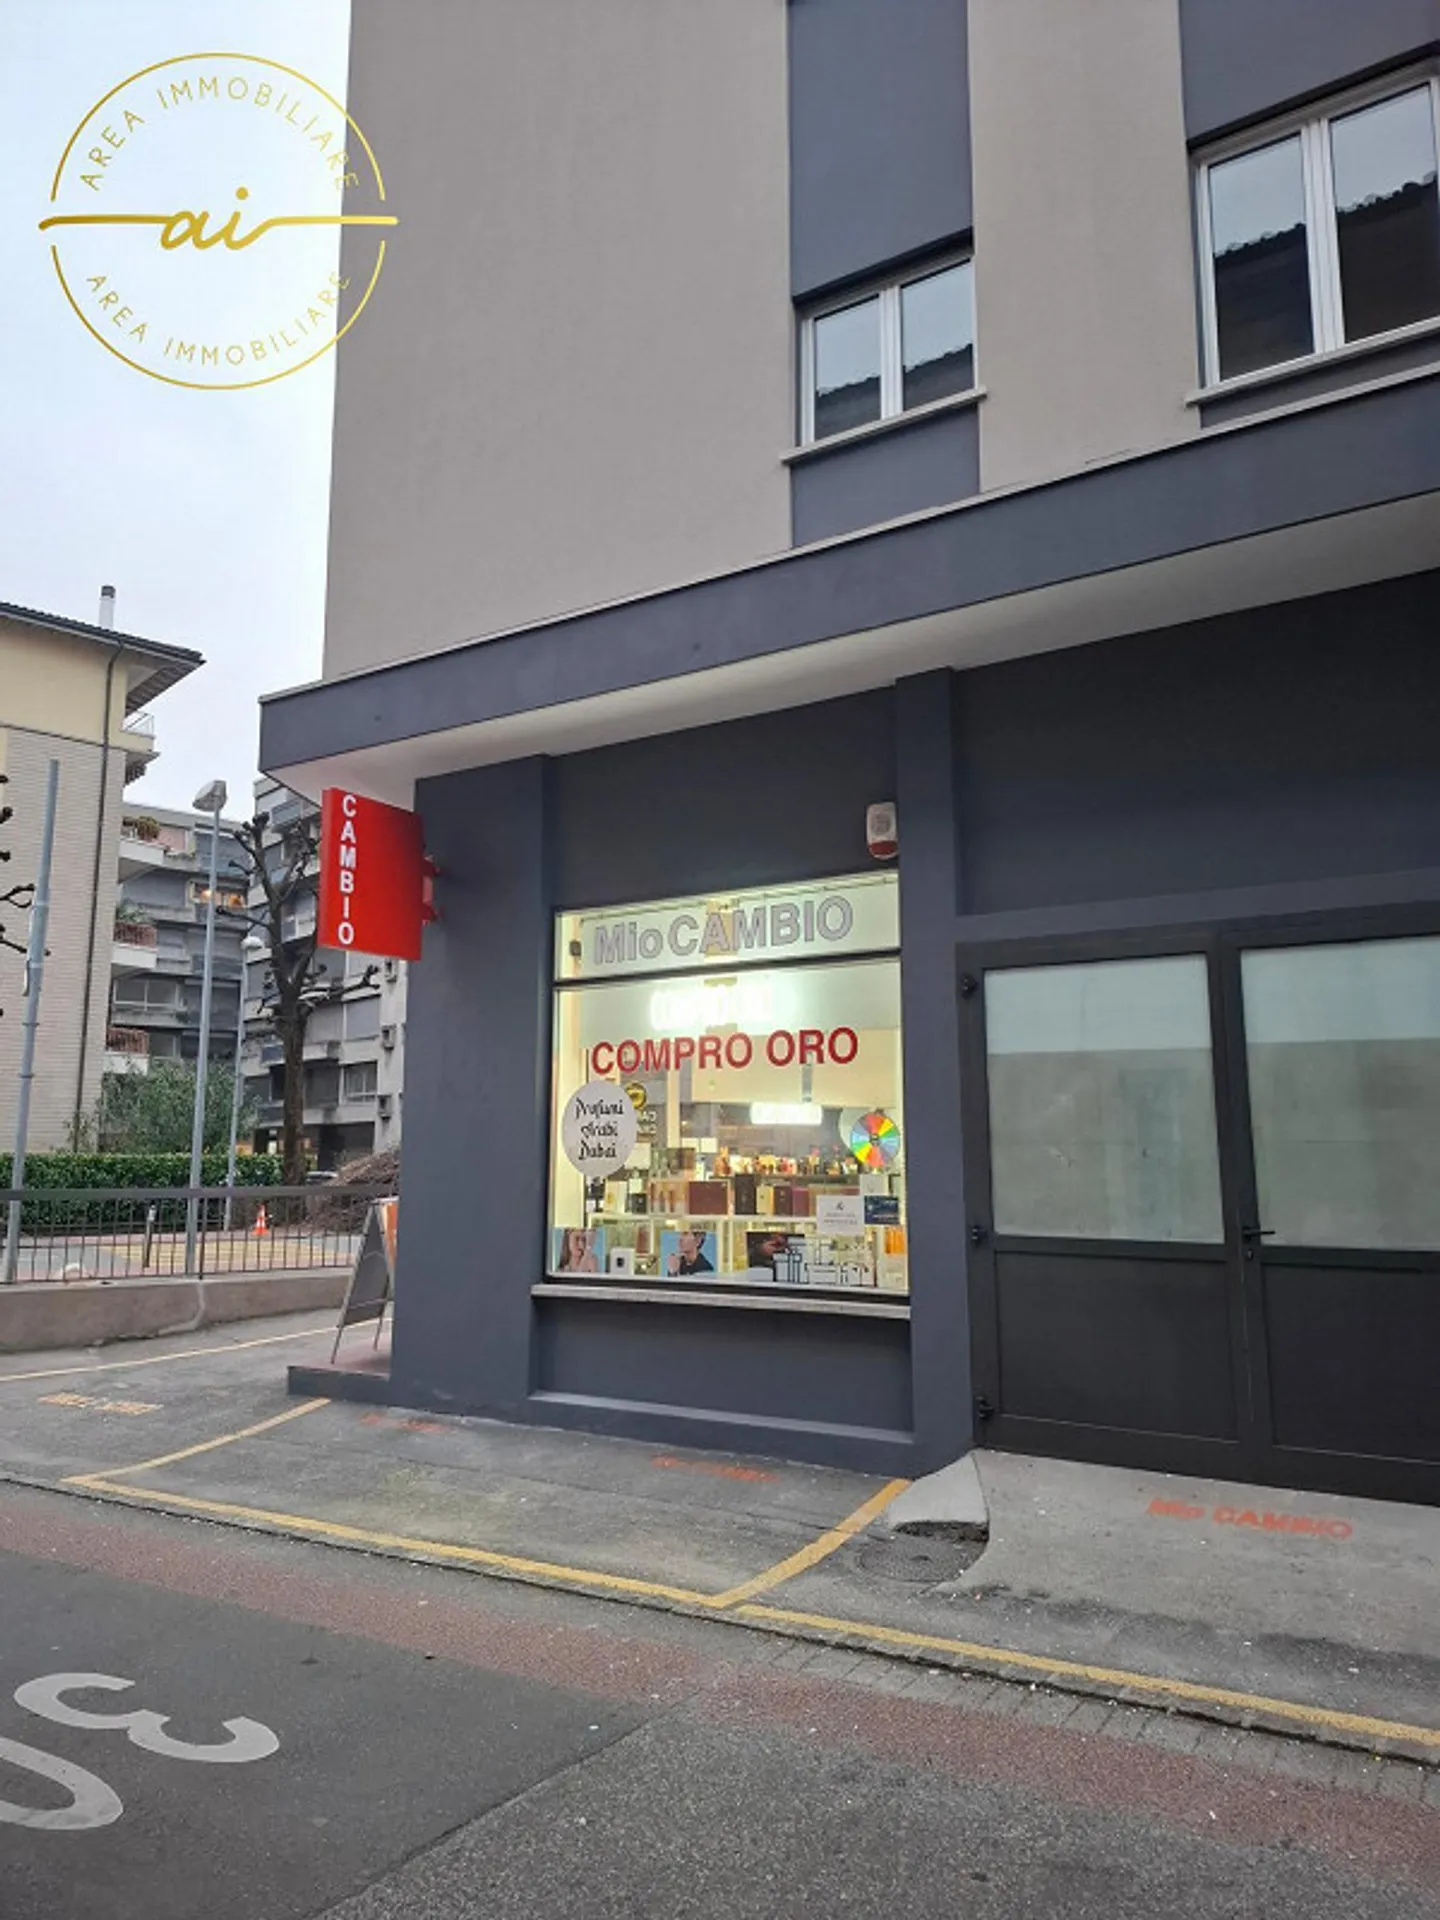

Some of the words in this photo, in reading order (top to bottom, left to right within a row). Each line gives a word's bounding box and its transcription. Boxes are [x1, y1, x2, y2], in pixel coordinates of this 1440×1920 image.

[337, 793, 357, 946] CAMBIO
[590, 1032, 753, 1076] COMPRO
[765, 1026, 859, 1068] ORO
[1212, 1505, 1354, 1540] CAMBIO
